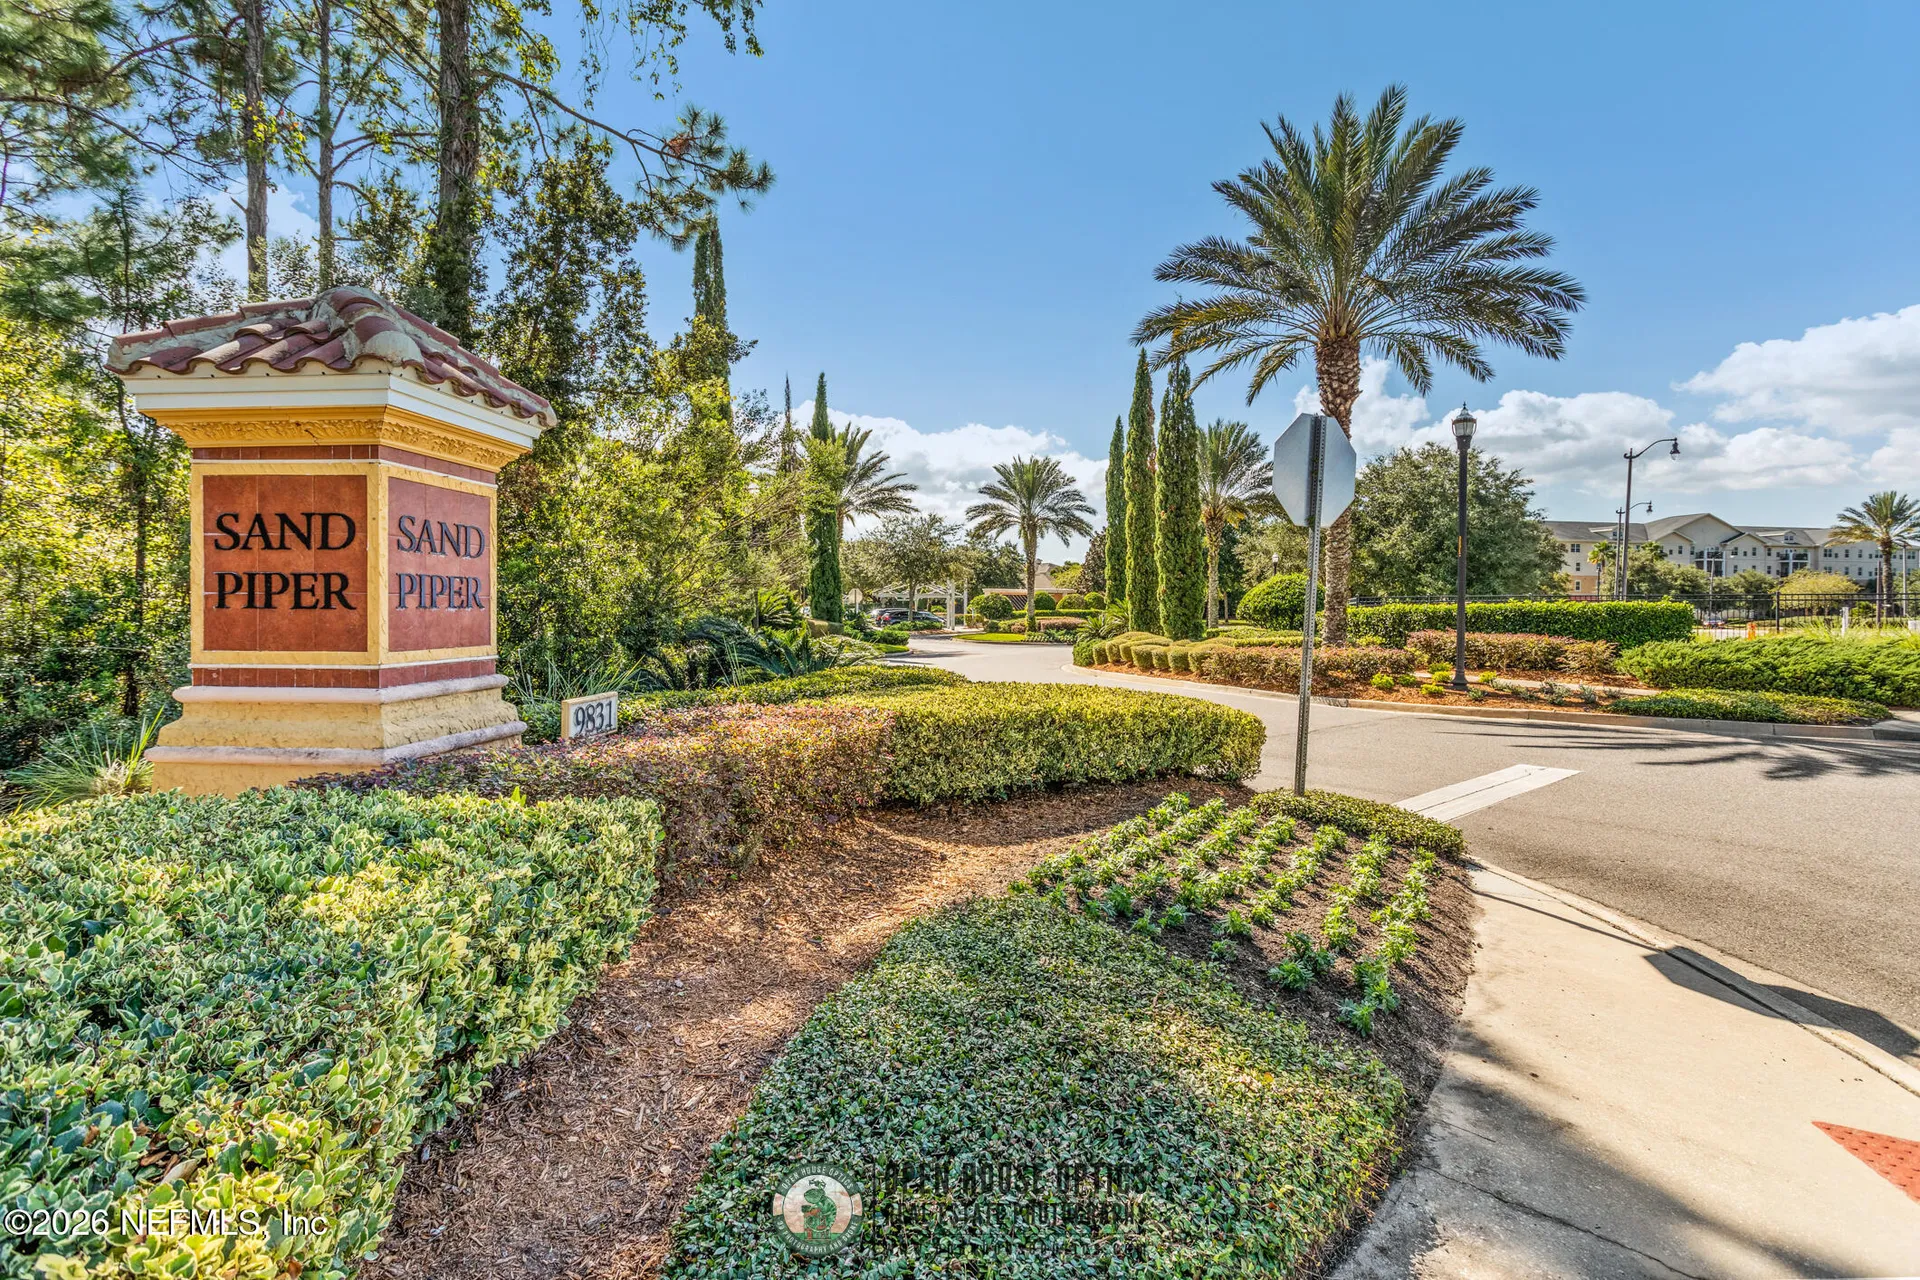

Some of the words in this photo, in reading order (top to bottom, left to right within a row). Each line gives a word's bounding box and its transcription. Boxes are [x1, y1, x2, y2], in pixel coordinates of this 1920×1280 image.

[214, 511, 356, 551] SAND
[397, 514, 486, 559] SAND
[213, 571, 357, 610] PIPER
[396, 572, 485, 611] PIPER
[574, 701, 613, 734] 9831
